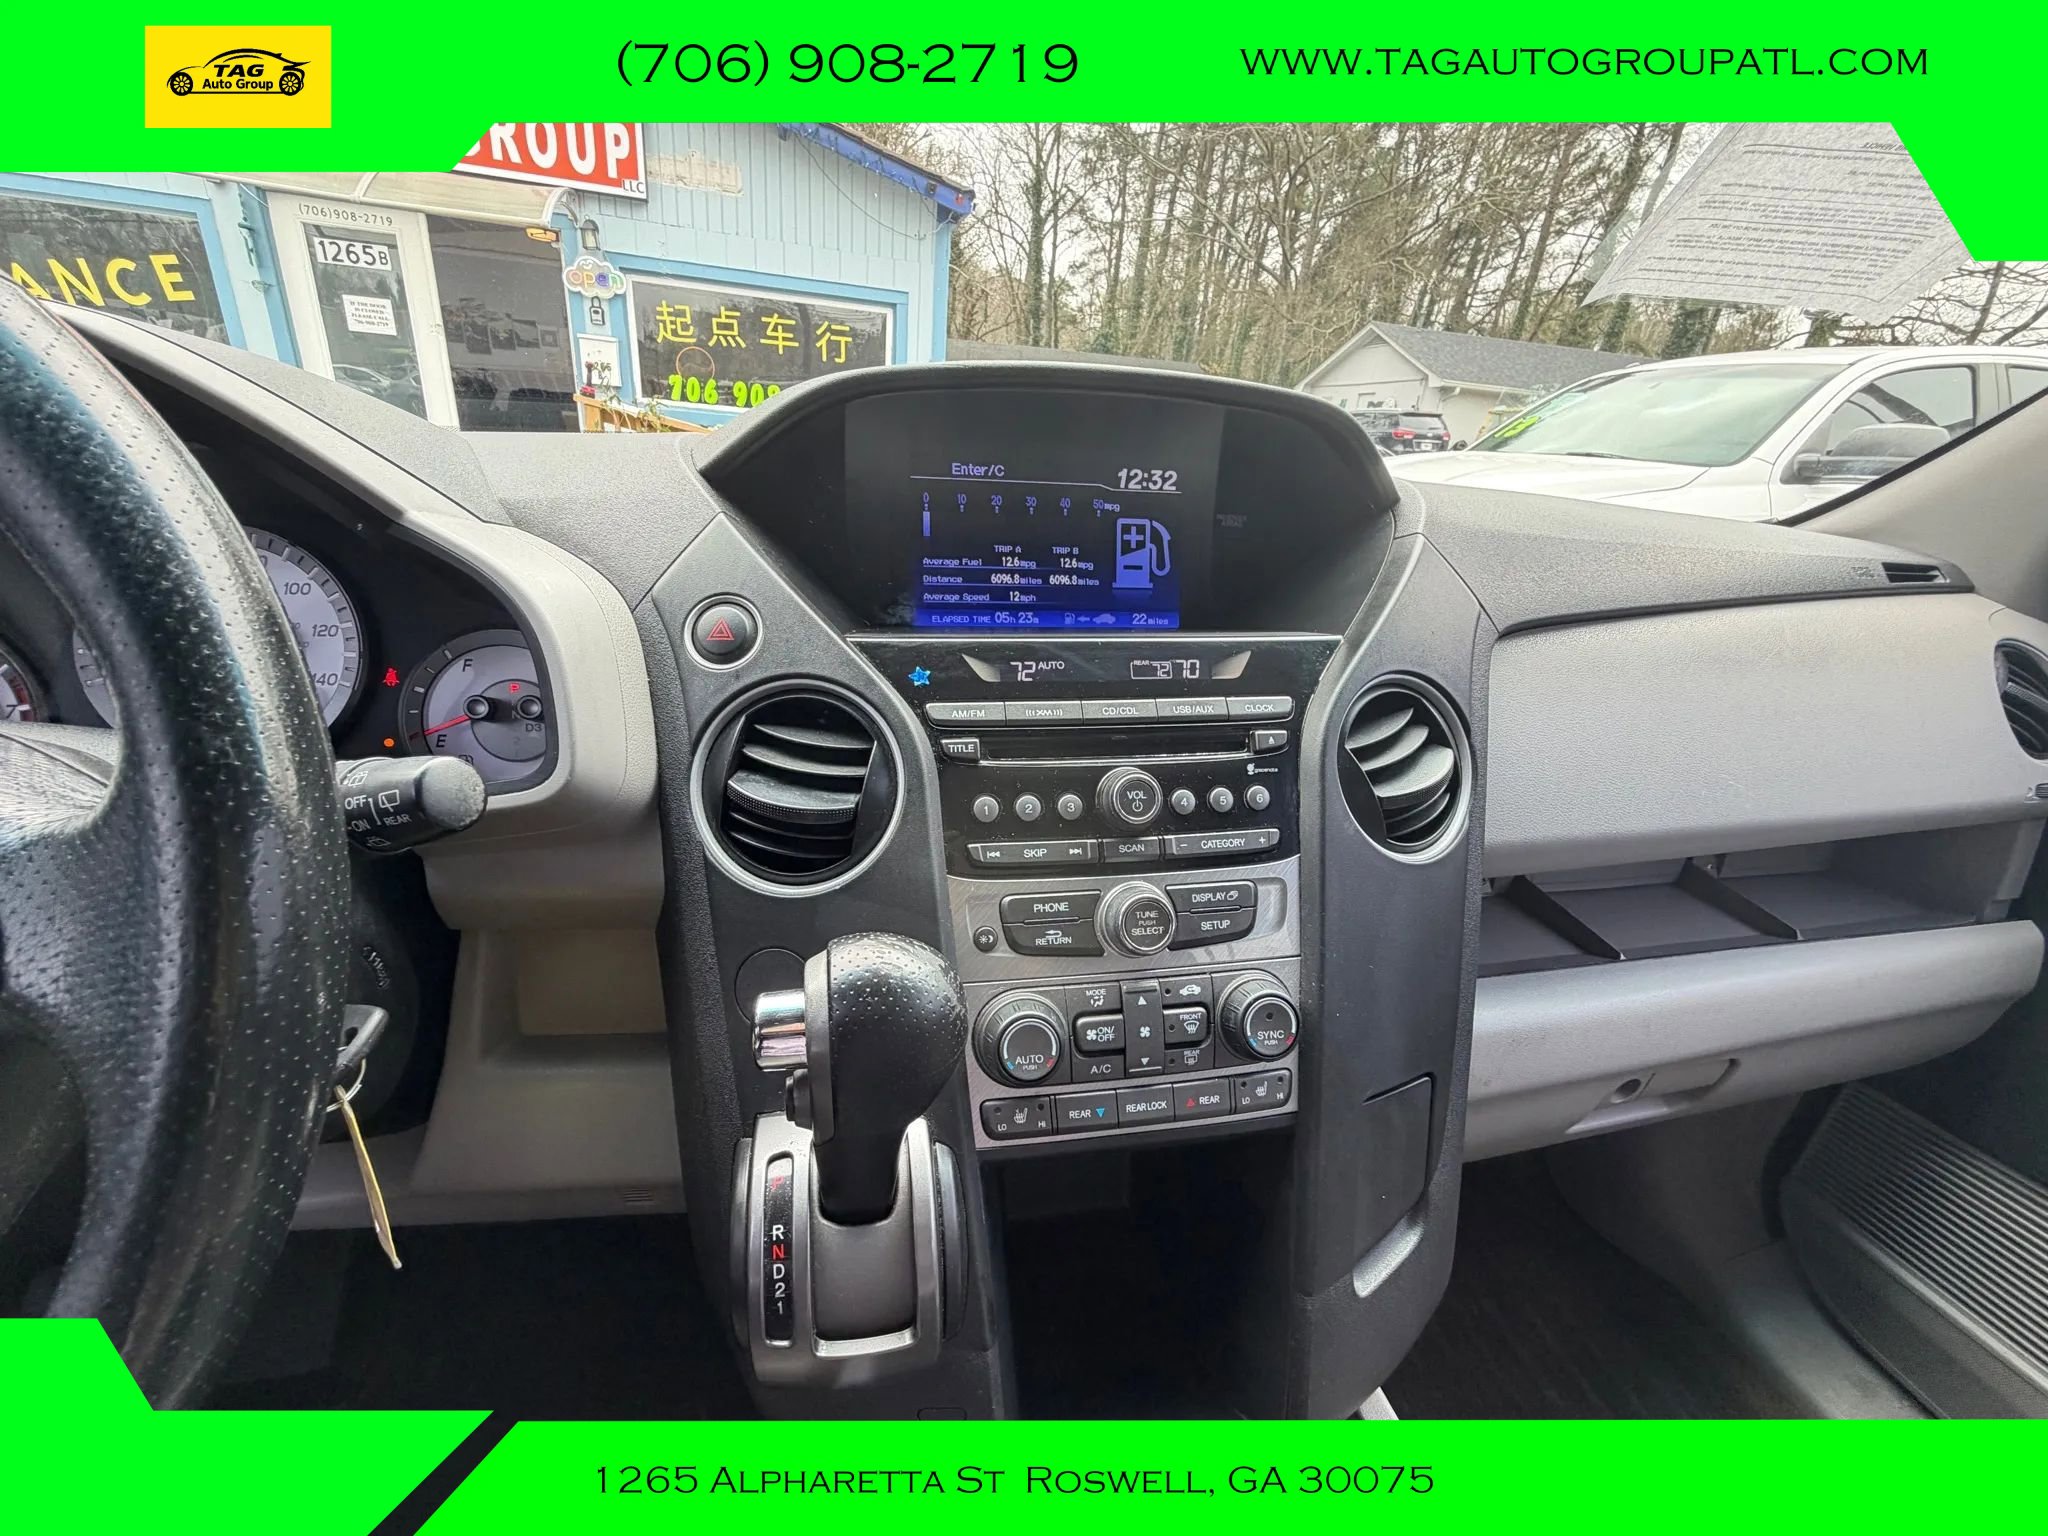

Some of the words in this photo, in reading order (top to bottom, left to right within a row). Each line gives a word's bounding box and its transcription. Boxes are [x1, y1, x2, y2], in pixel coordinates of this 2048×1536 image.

[464, 123, 631, 179] ROUP
[622, 179, 645, 194] LLC
[299, 203, 393, 226] (706)908-2719
[656, 300, 852, 363] 起点车行
[669, 374, 718, 405] 706
[952, 463, 1005, 476] Enter/C
[1117, 468, 1178, 491] 12:32
[957, 493, 967, 504] 10
[991, 495, 1002, 506] 20
[1025, 496, 1036, 507] 30
[1059, 498, 1071, 508] 40
[994, 545, 1012, 553] TRIP
[1052, 547, 1070, 555] TRIP
[923, 557, 959, 567] Average
[962, 558, 982, 566] Fuel
[923, 575, 962, 583] Distance
[283, 582, 312, 596] 100
[923, 592, 960, 603] Average
[963, 593, 989, 603] Speed
[932, 615, 969, 624] ELAPSED
[311, 624, 340, 638] 120
[462, 658, 474, 673] F
[1010, 661, 1036, 681] 72
[1038, 661, 1064, 670] AUTO
[1151, 663, 1168, 677] 72
[1176, 659, 1199, 678] 70
[509, 683, 520, 694] P
[1173, 705, 1214, 714] USB/AUX
[1245, 703, 1274, 712] CLOCK
[952, 710, 985, 718] AM/FM
[525, 723, 543, 733] D3
[435, 734, 448, 748] E
[948, 744, 975, 753] TITLE
[1127, 790, 1147, 800] VOL
[1256, 793, 1264, 803] 6
[344, 795, 368, 810] OFF
[1180, 797, 1189, 807] 4
[1219, 796, 1227, 806] 5
[983, 805, 989, 816] 1
[1025, 803, 1033, 814] 2
[1067, 802, 1075, 812] 3
[351, 818, 372, 832] ON
[383, 813, 412, 826] REAR
[1118, 844, 1145, 853] SCAN
[1200, 838, 1245, 849] CATEGORY
[1023, 848, 1047, 858] SKIP
[1191, 892, 1226, 903] DISPLAY
[1033, 902, 1070, 913] PHONE
[1135, 911, 1159, 919] TUNE
[1131, 926, 1164, 936] SELECT
[1200, 920, 1231, 931] SETUP
[1035, 936, 1073, 946] RETURN
[1097, 1026, 1115, 1034] ON/
[1257, 1030, 1285, 1040] SYNC
[1097, 1034, 1115, 1042] OFF
[1015, 1055, 1044, 1065] AUTO
[1090, 1064, 1112, 1075] A/C
[1199, 1095, 1220, 1105] REAR
[1242, 1096, 1251, 1104] LO
[1276, 1092, 1285, 1100] HI
[1126, 1104, 1147, 1113] REAR
[1147, 1101, 1168, 1111] LOCK
[1069, 1110, 1092, 1119] REAR
[998, 1123, 1007, 1132] LO
[772, 1224, 785, 1241] R
[772, 1244, 785, 1260] N
[773, 1263, 785, 1280] D
[774, 1282, 786, 1298] 2
[777, 1301, 784, 1315] 1
